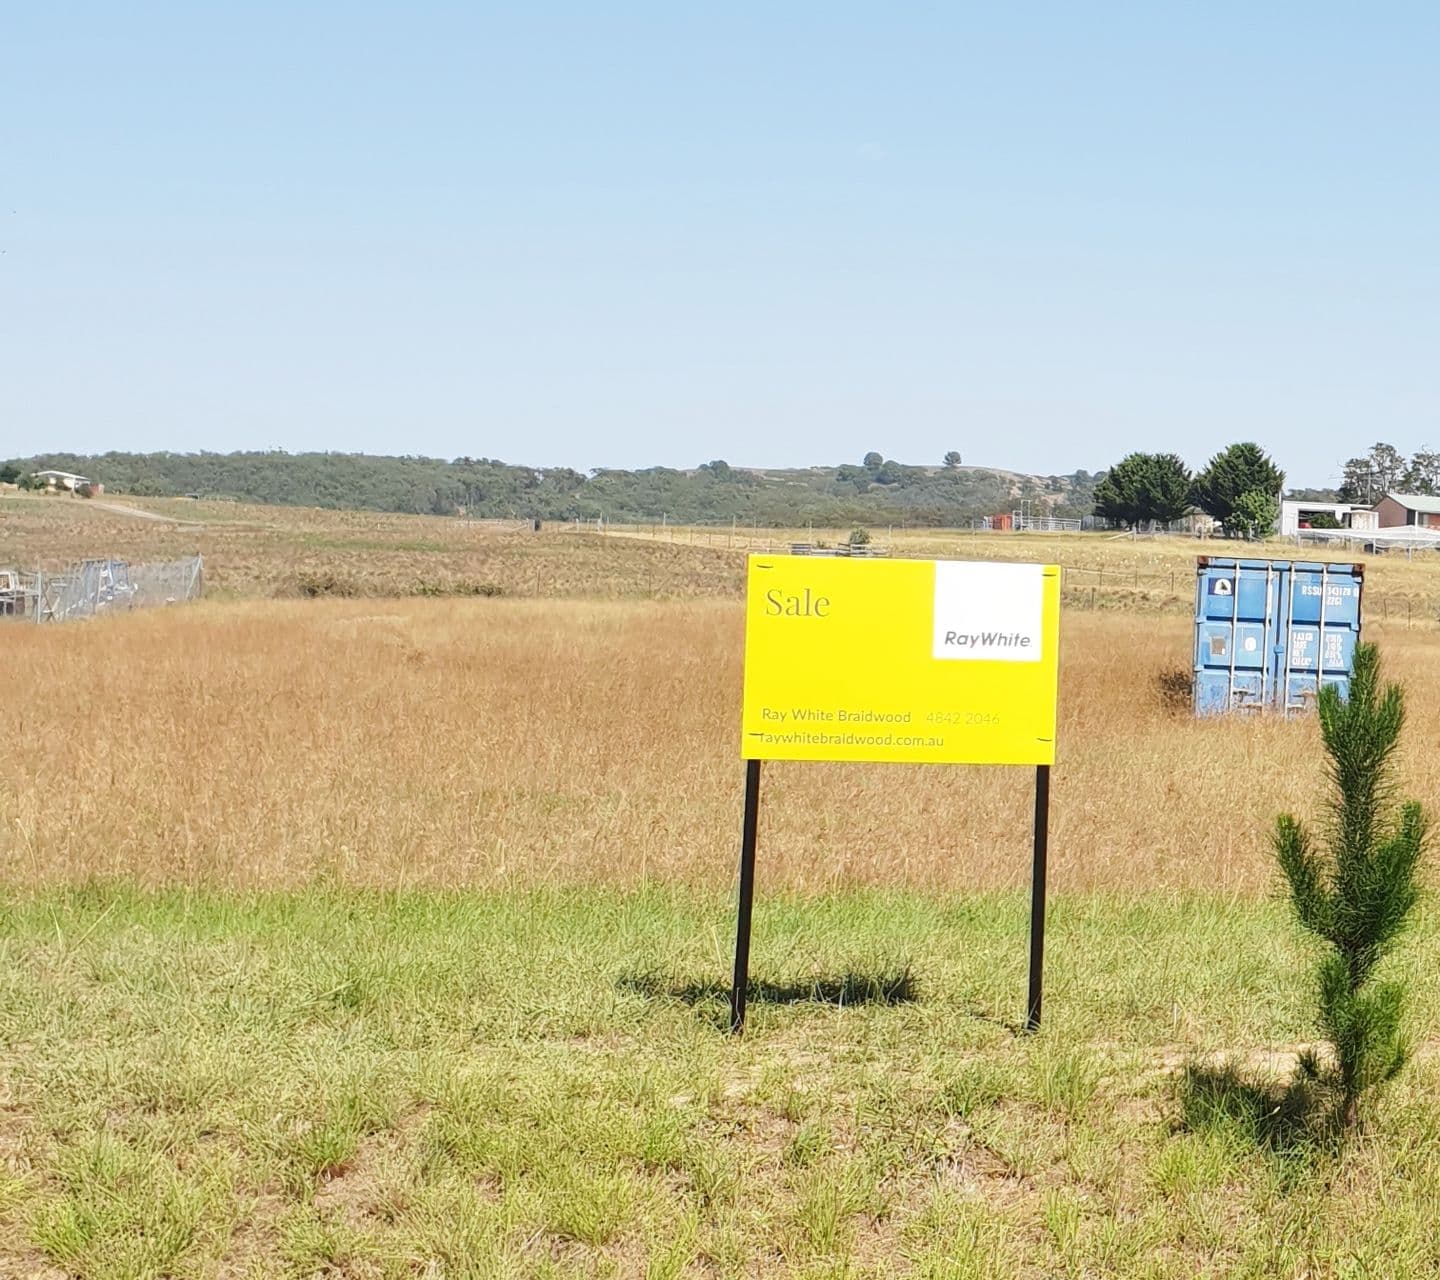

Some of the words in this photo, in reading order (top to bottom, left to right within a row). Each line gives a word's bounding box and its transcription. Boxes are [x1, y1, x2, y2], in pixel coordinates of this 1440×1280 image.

[765, 587, 830, 617] Sale
[762, 707, 787, 722] Ray
[792, 708, 834, 722] White
[838, 709, 912, 723] Braidwood
